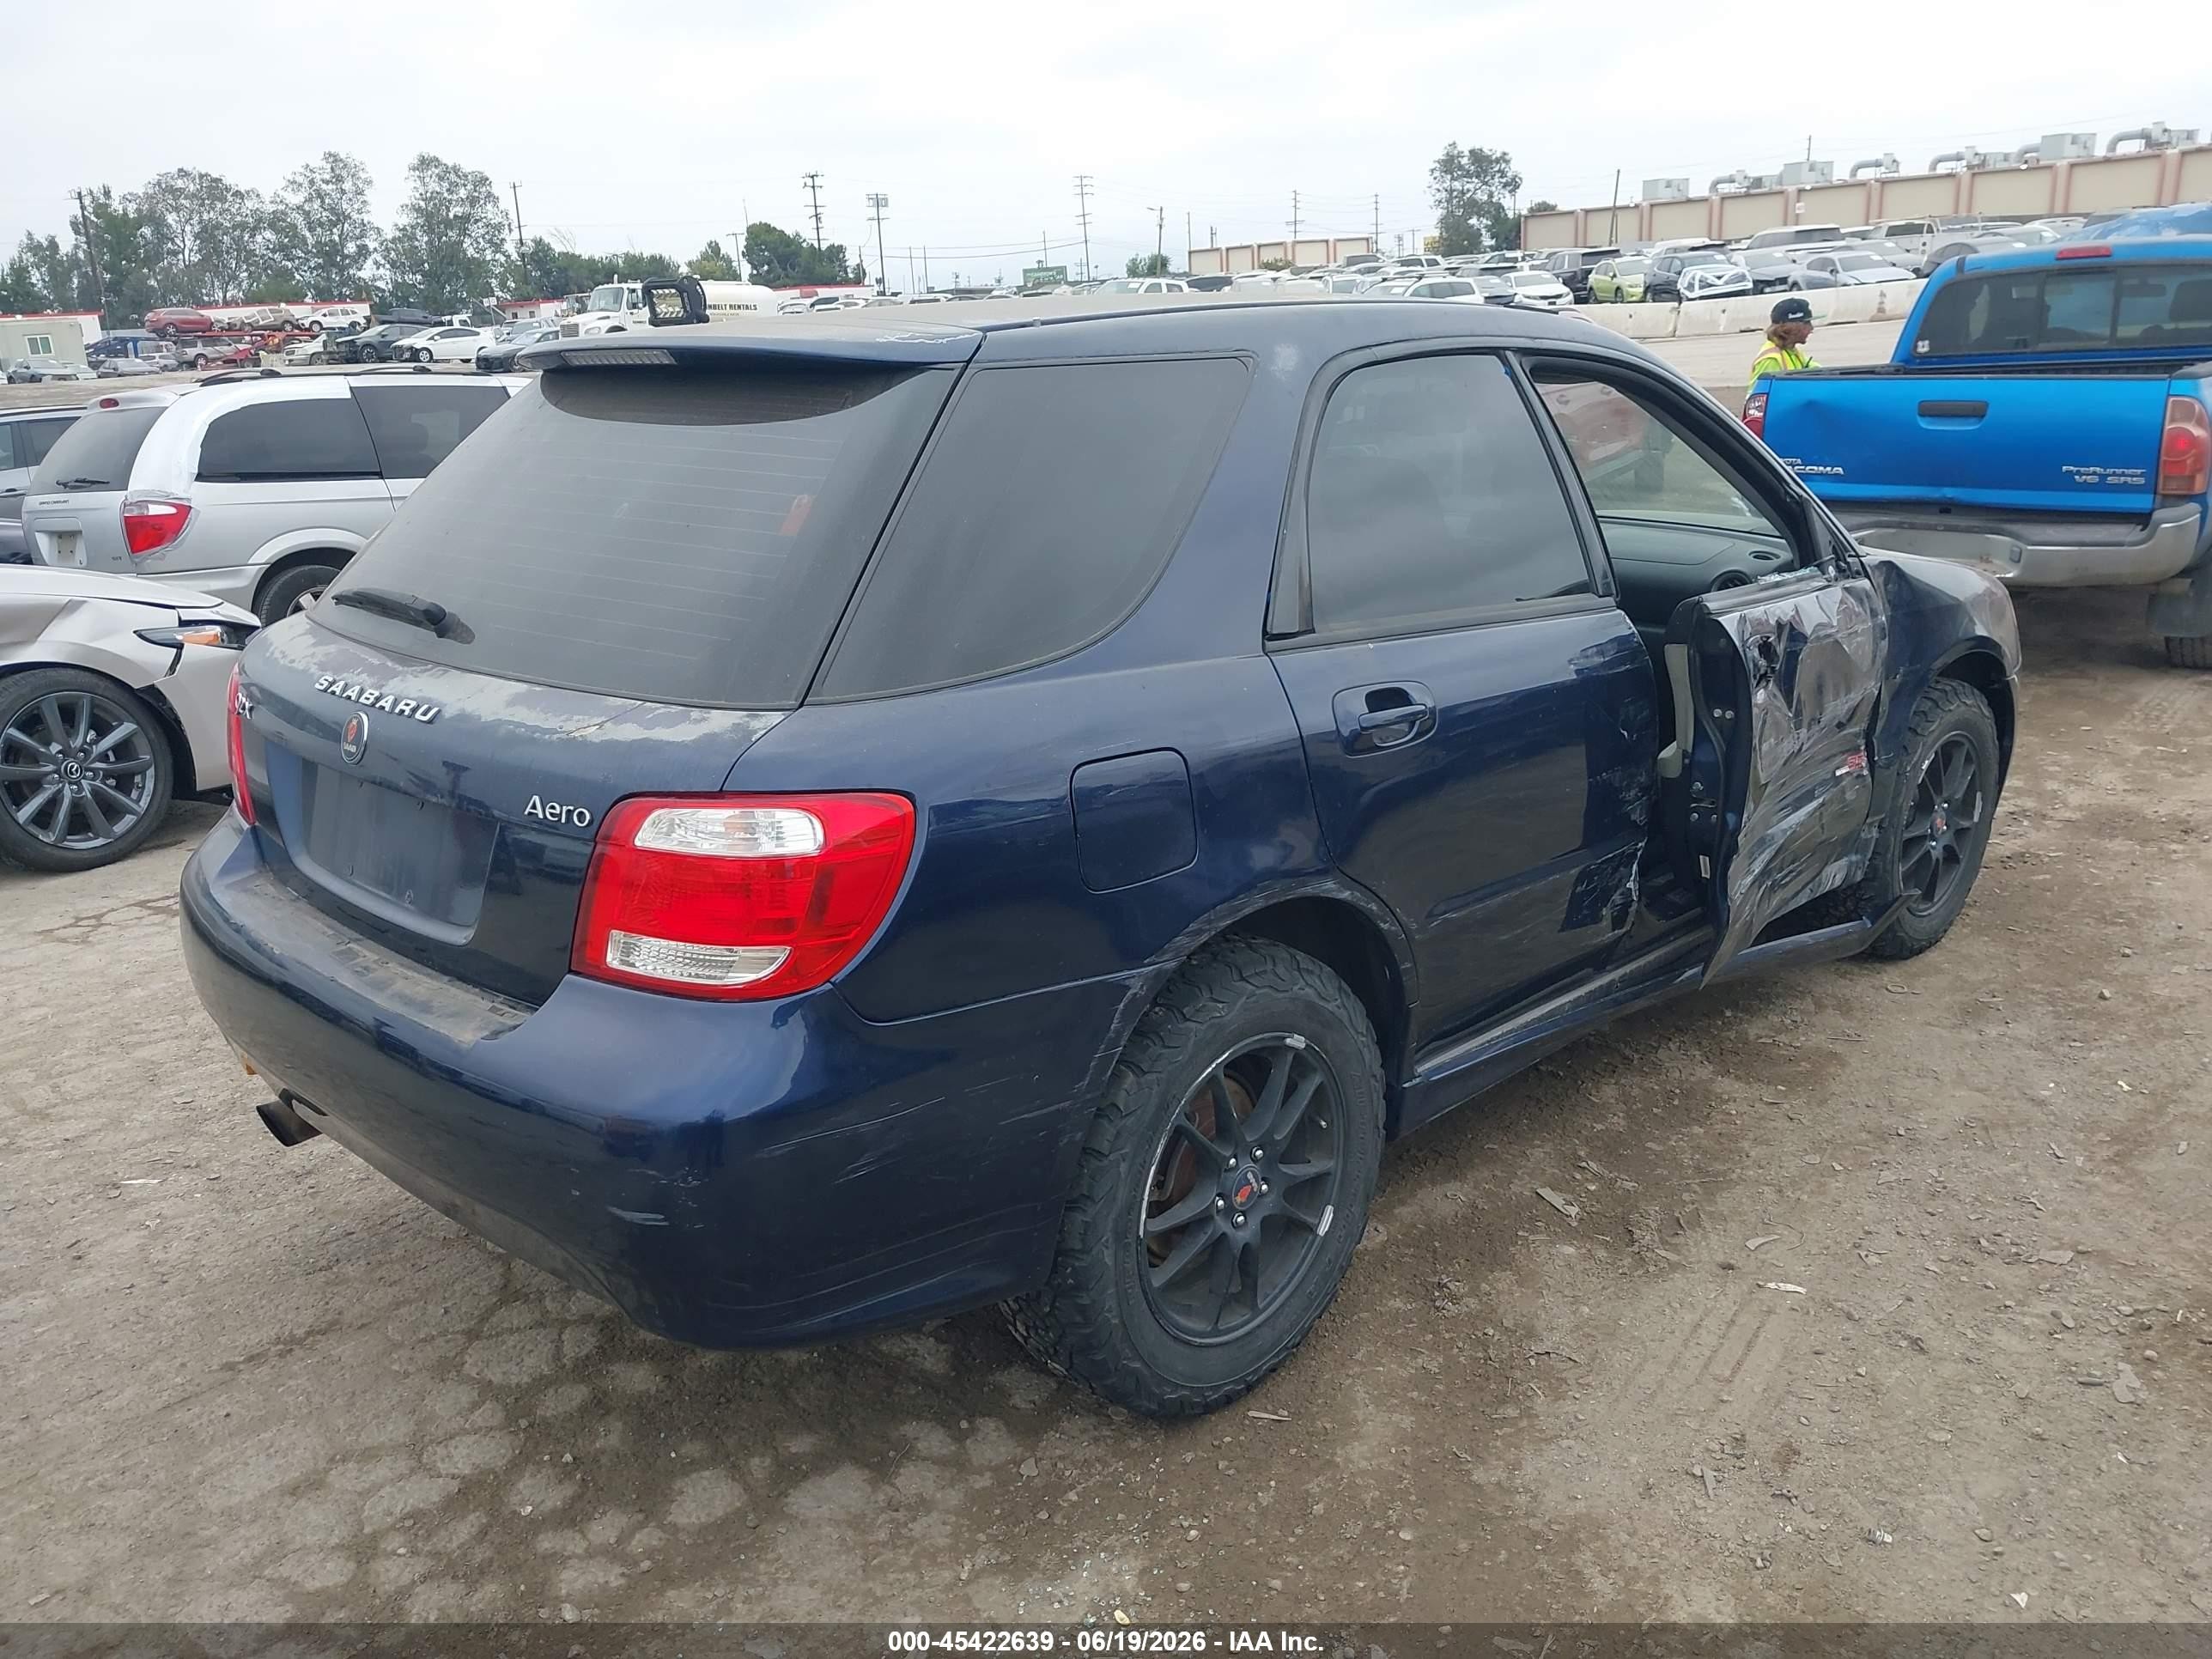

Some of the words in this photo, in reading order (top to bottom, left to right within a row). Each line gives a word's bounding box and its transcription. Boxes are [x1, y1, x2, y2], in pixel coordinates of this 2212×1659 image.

[2062, 465, 2146, 475] PreRunner
[2074, 475, 2100, 483] V6
[315, 675, 441, 723] SAABARU
[524, 794, 592, 827] Aero
